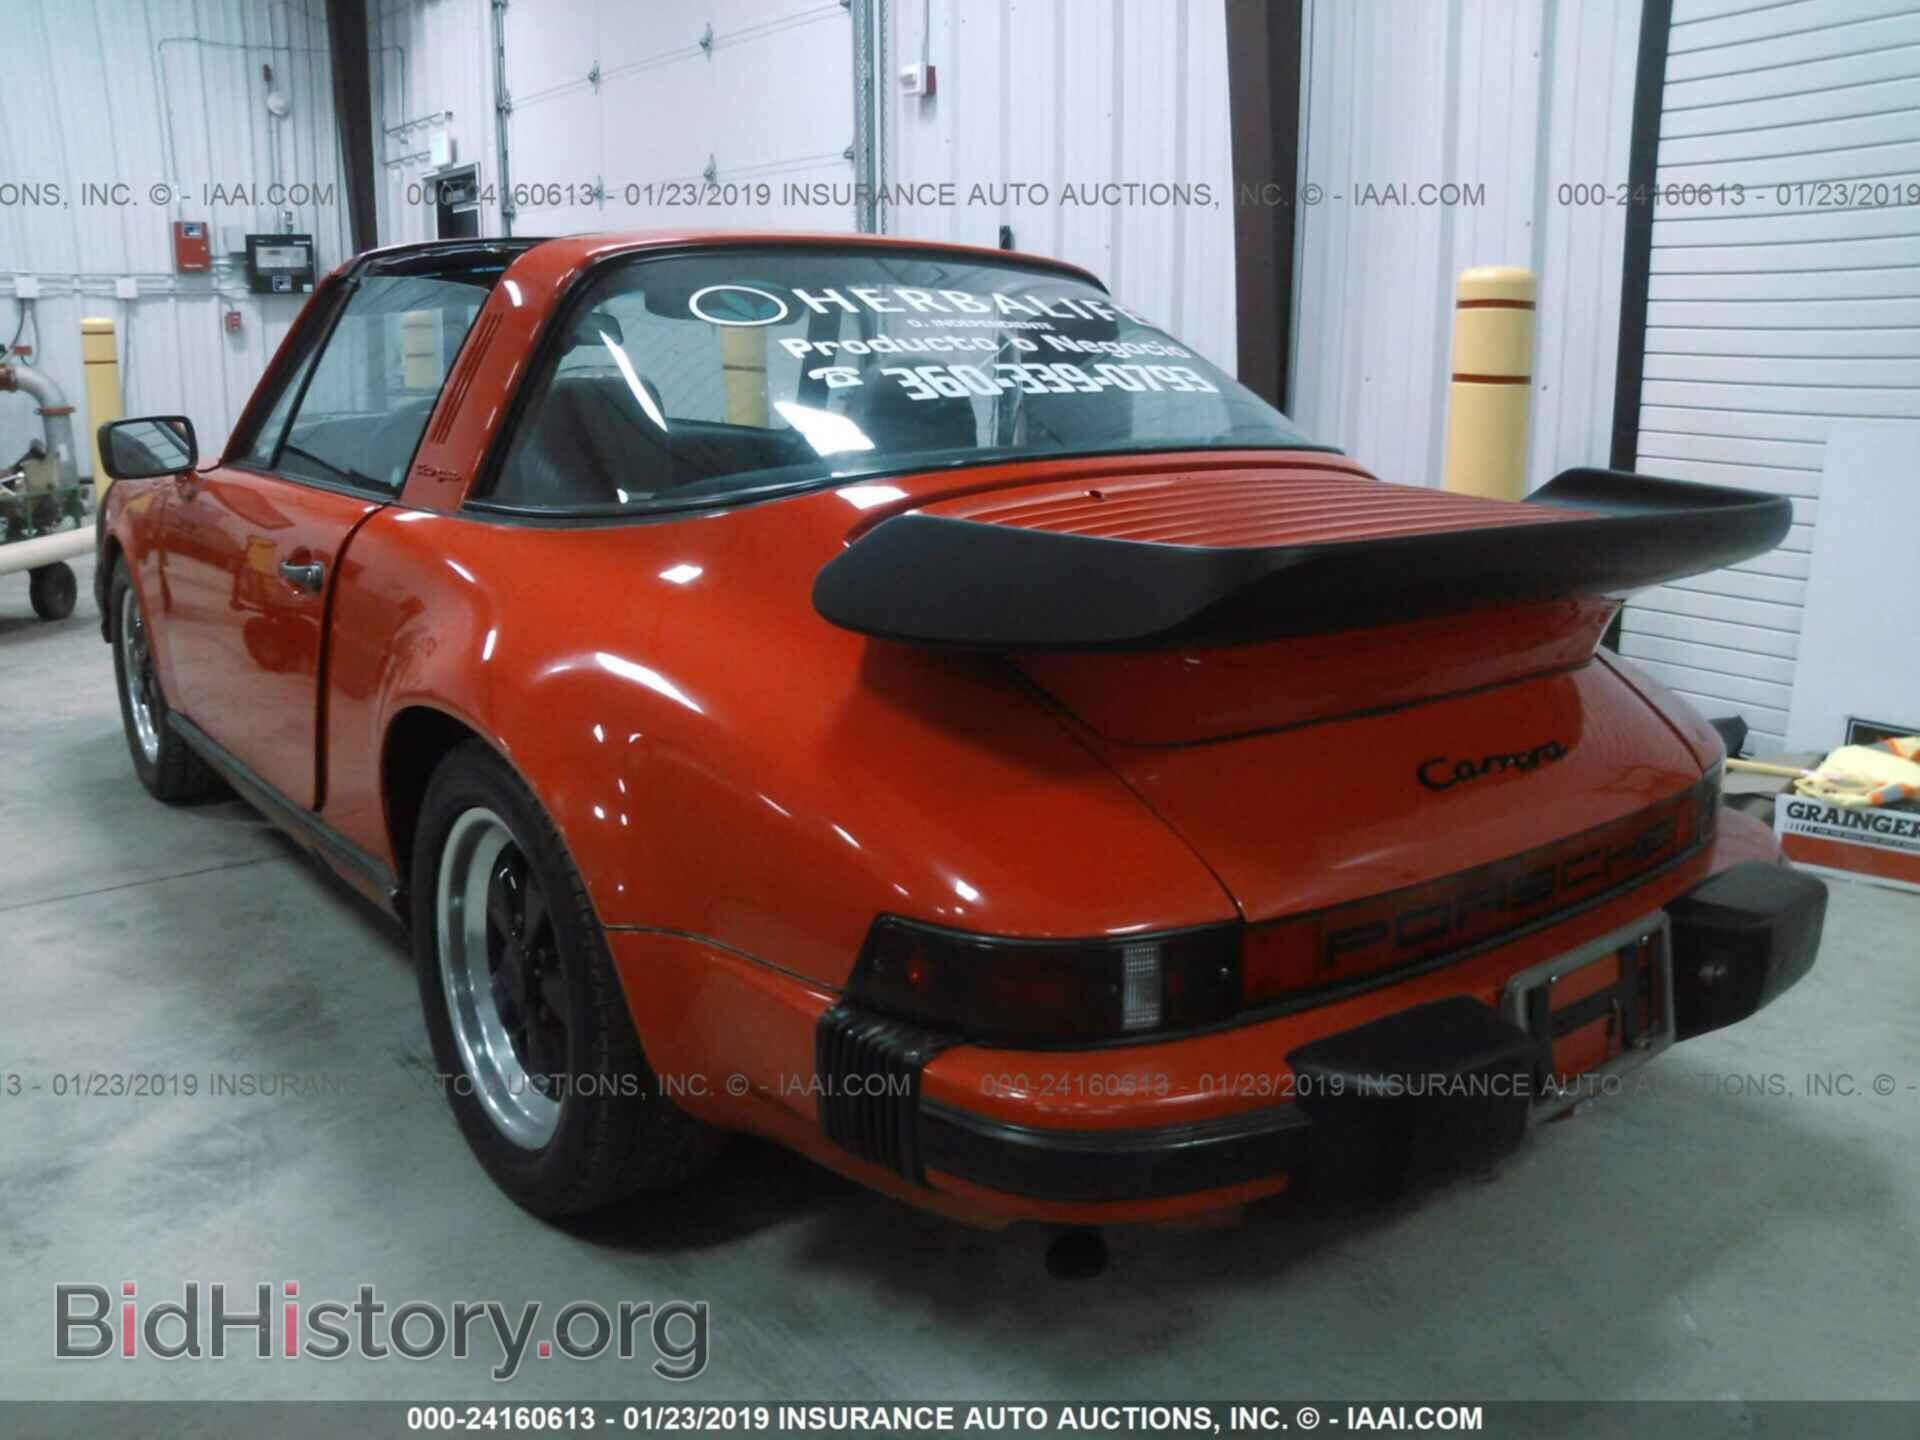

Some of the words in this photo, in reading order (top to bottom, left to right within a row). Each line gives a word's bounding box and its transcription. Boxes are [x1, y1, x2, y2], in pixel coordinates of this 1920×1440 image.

[779, 333, 998, 359] Producto
[1010, 337, 1039, 352] o
[1040, 334, 1192, 358] Negocio
[880, 362, 1219, 400] 360-339-0793
[1322, 816, 1674, 968] PORSCHE
